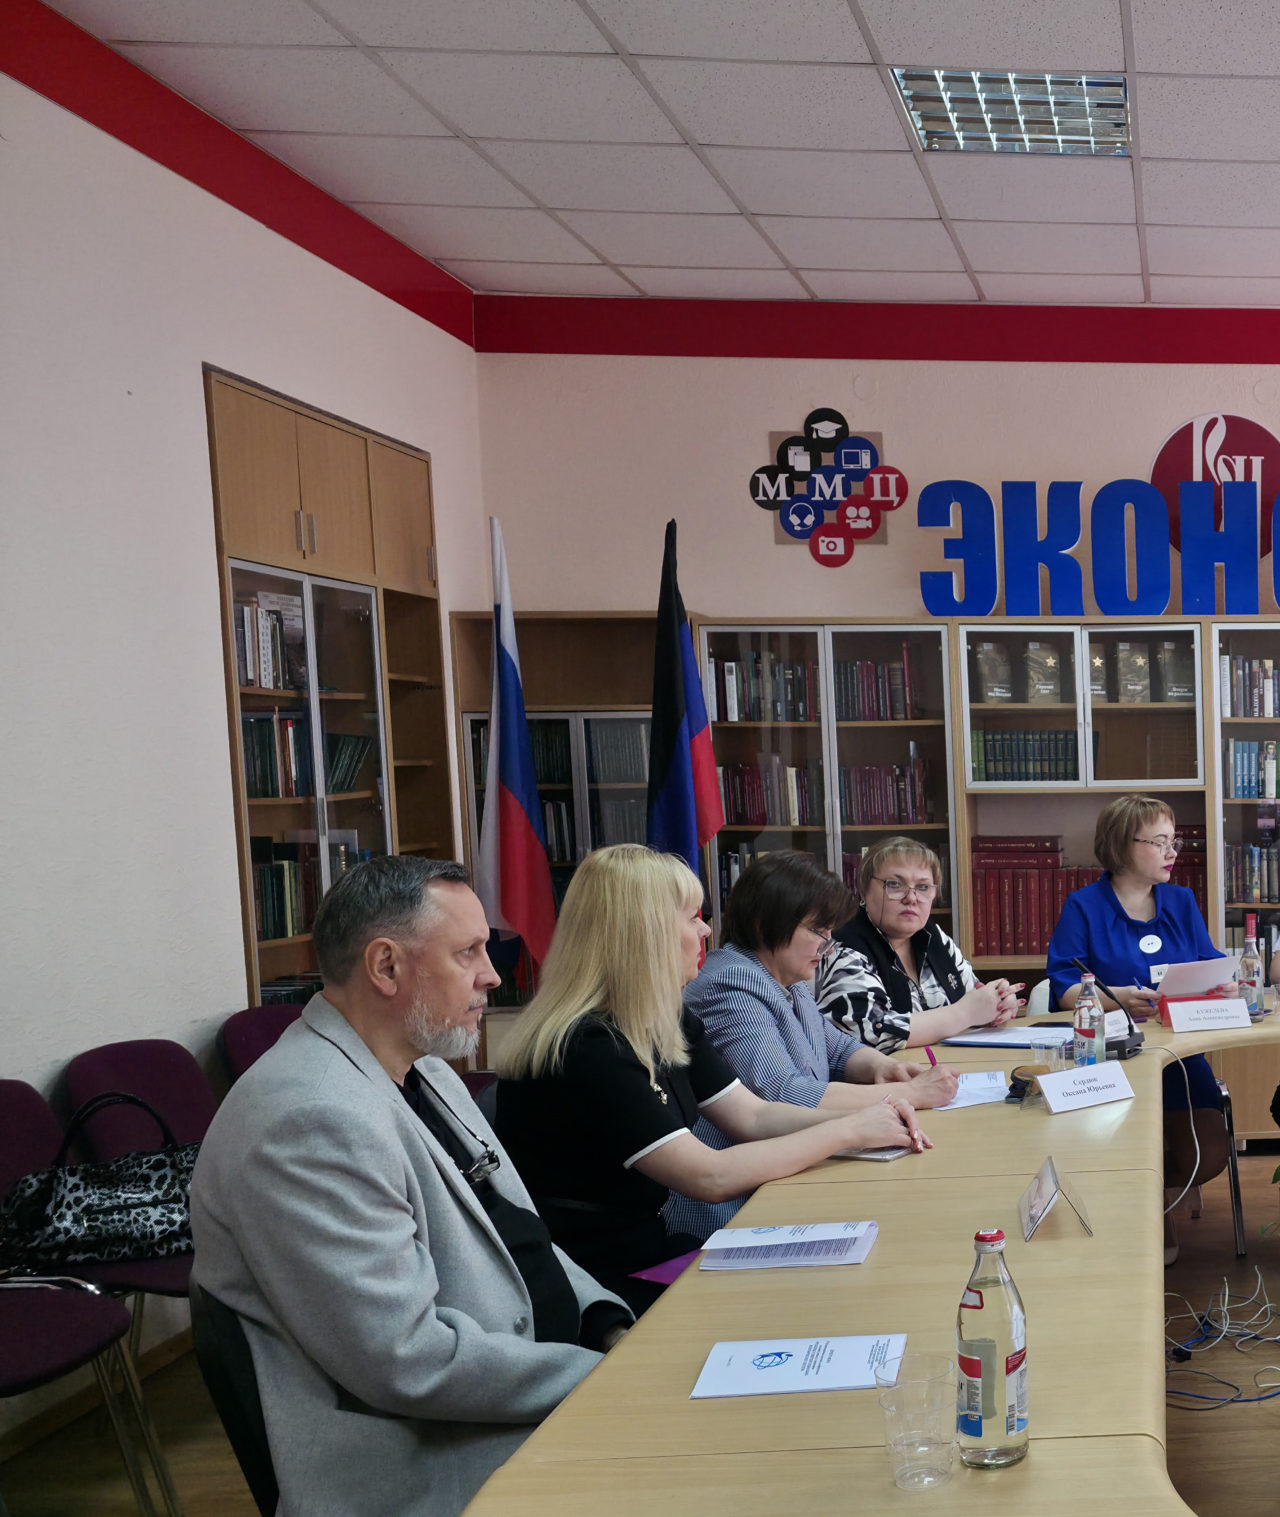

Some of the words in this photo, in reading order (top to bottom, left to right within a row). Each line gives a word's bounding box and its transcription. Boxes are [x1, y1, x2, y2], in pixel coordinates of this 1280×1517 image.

[1072, 1076, 1099, 1087] Сердюк
[1062, 1087, 1088, 1098] Оксана
[1087, 1082, 1117, 1094] Юрьевна
